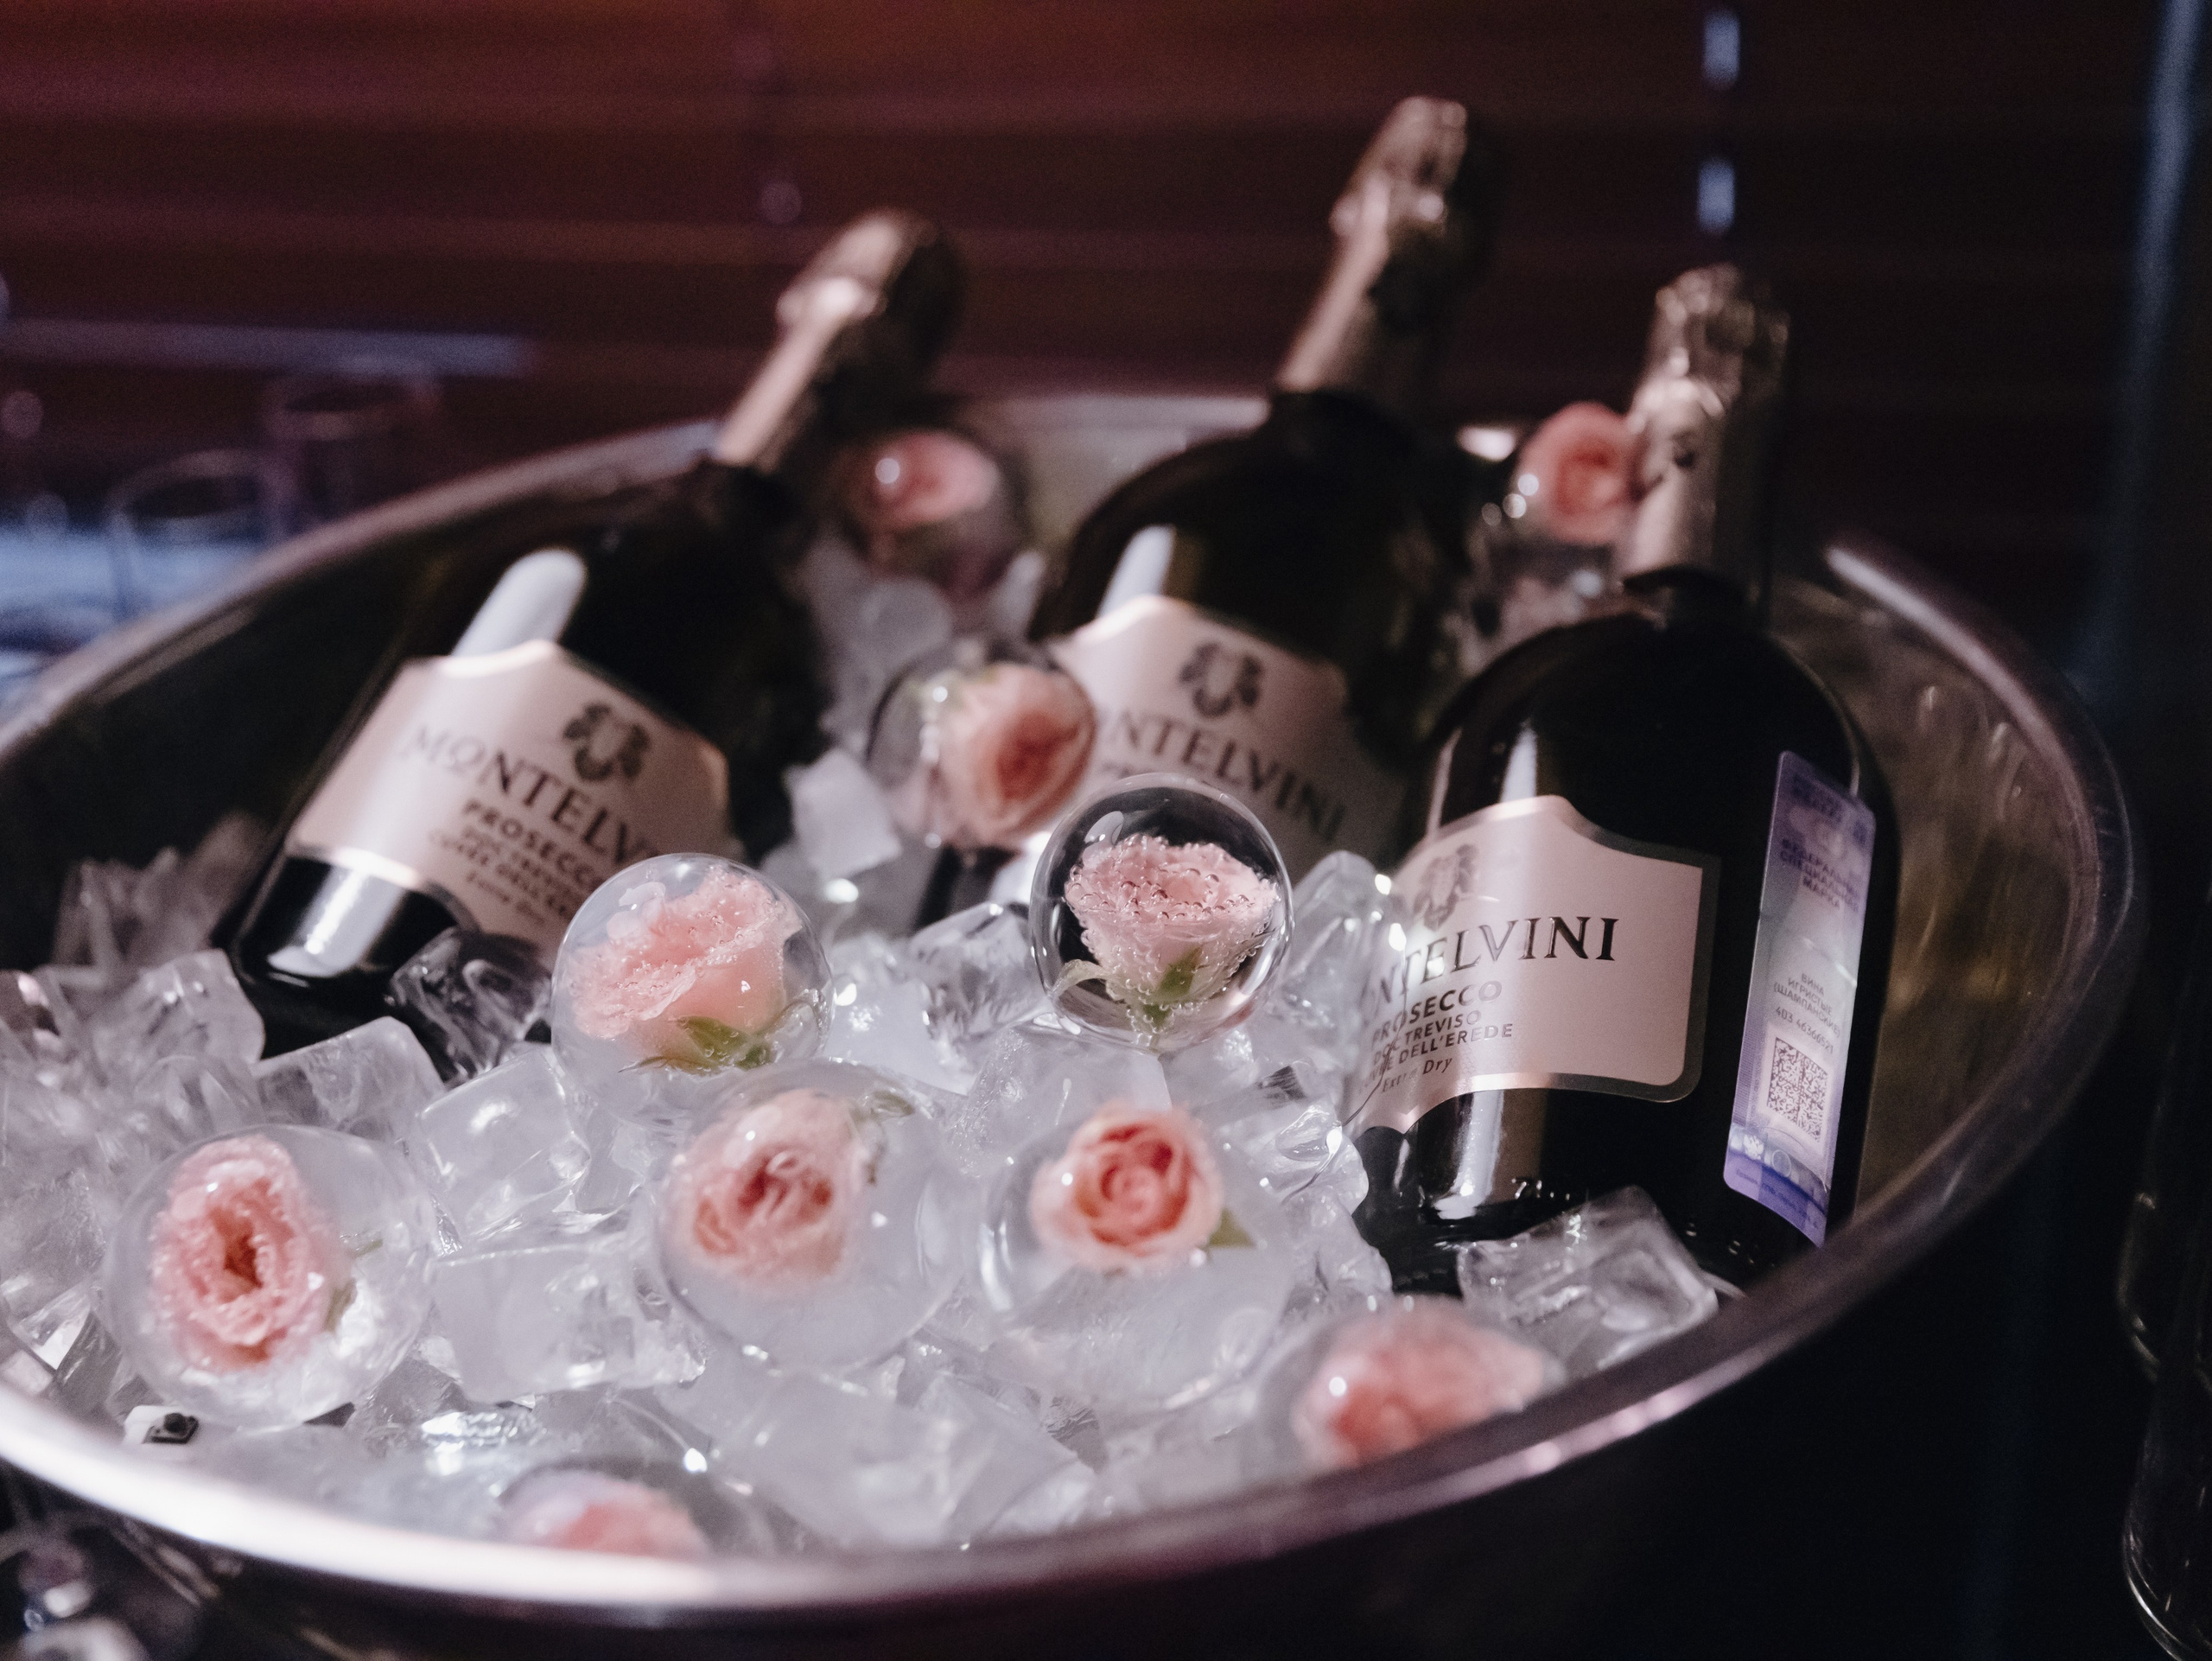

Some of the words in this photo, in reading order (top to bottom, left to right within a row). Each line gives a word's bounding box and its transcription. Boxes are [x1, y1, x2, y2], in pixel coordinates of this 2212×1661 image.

[400, 722, 657, 864] MONTELV
[1109, 712, 1346, 845] NTELVINI
[1788, 977, 1833, 1015] ИГРИСТЫЕ
[1801, 972, 1825, 996] ВИНА
[1370, 980, 1503, 1049] PROSECCO
[1404, 1009, 1482, 1044] TREVISO
[1776, 1006, 1794, 1023] 403
[1398, 1023, 1513, 1064] DELL'EREDE
[1422, 1057, 1453, 1076] Dry
